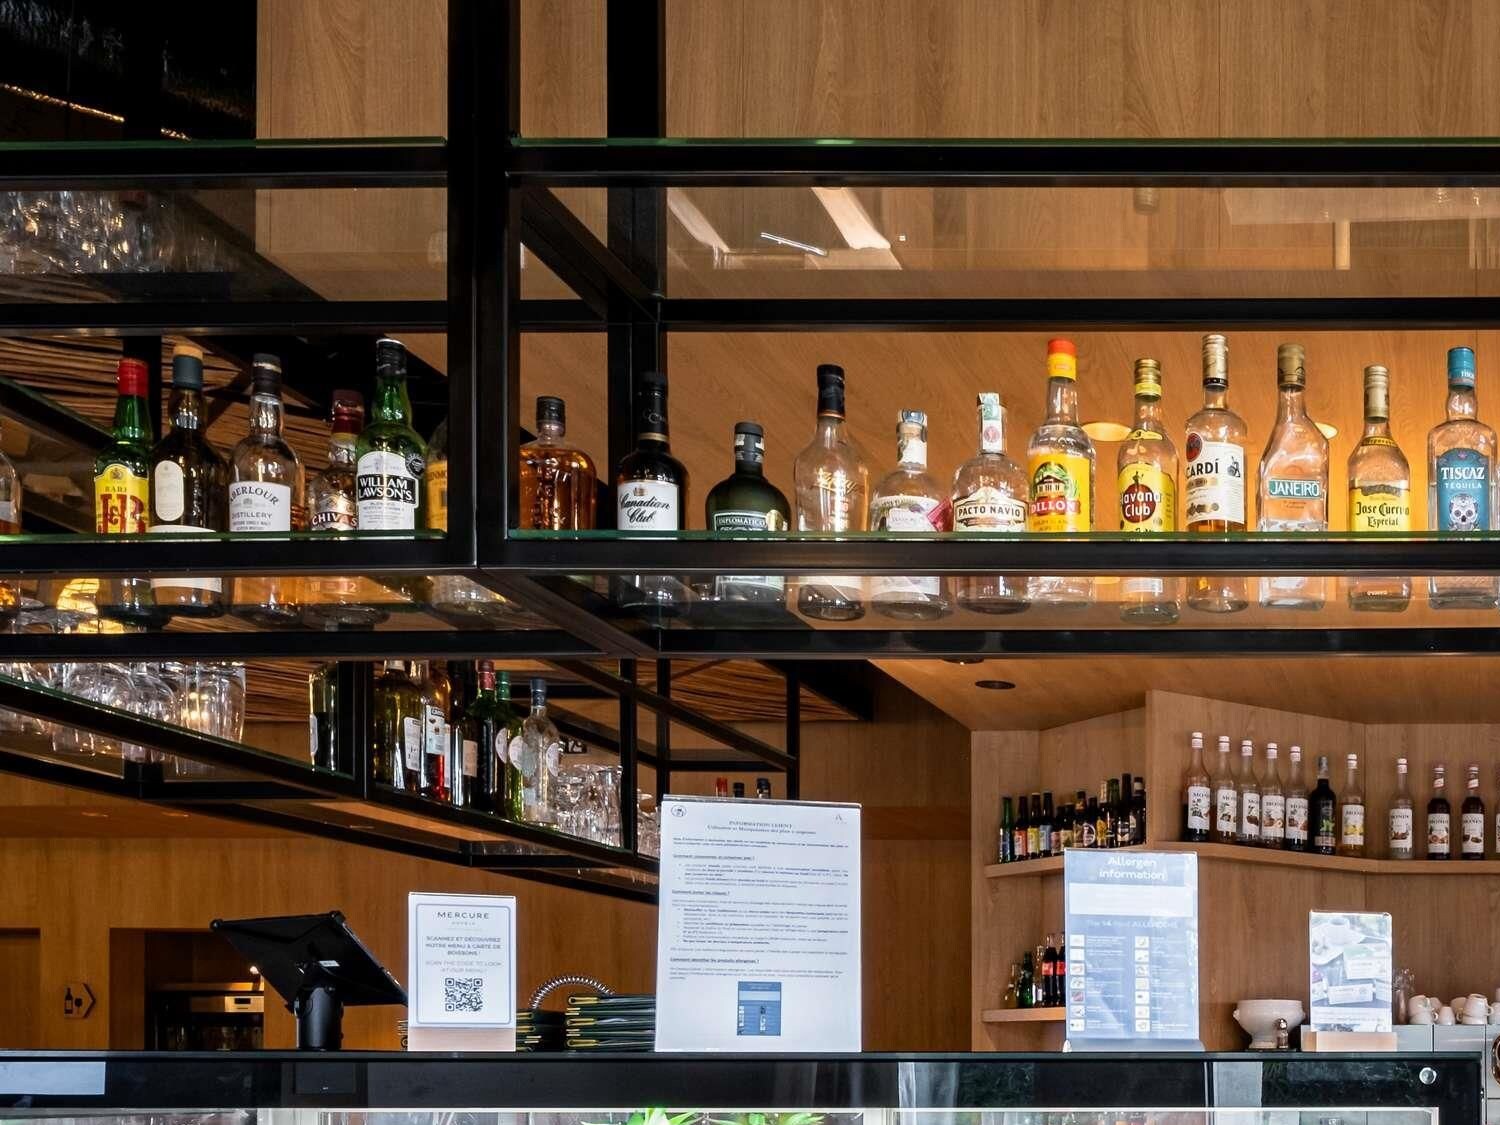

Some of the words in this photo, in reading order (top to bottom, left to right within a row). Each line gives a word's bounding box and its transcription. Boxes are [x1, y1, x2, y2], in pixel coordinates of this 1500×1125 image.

[1440, 466, 1485, 480] TISCAZ
[359, 477, 408, 490] WILLIAM
[1270, 480, 1320, 497] JANEIRO
[1445, 482, 1482, 490] TEQUILA
[358, 486, 413, 501] LAWSON'S
[619, 490, 670, 509] Canadian
[958, 504, 986, 517] PACTO
[989, 505, 1021, 517] NAVIO
[1031, 500, 1077, 514] DILLON
[1124, 502, 1151, 517] Club
[627, 506, 656, 524] Club
[436, 911, 490, 920] MERCURE
